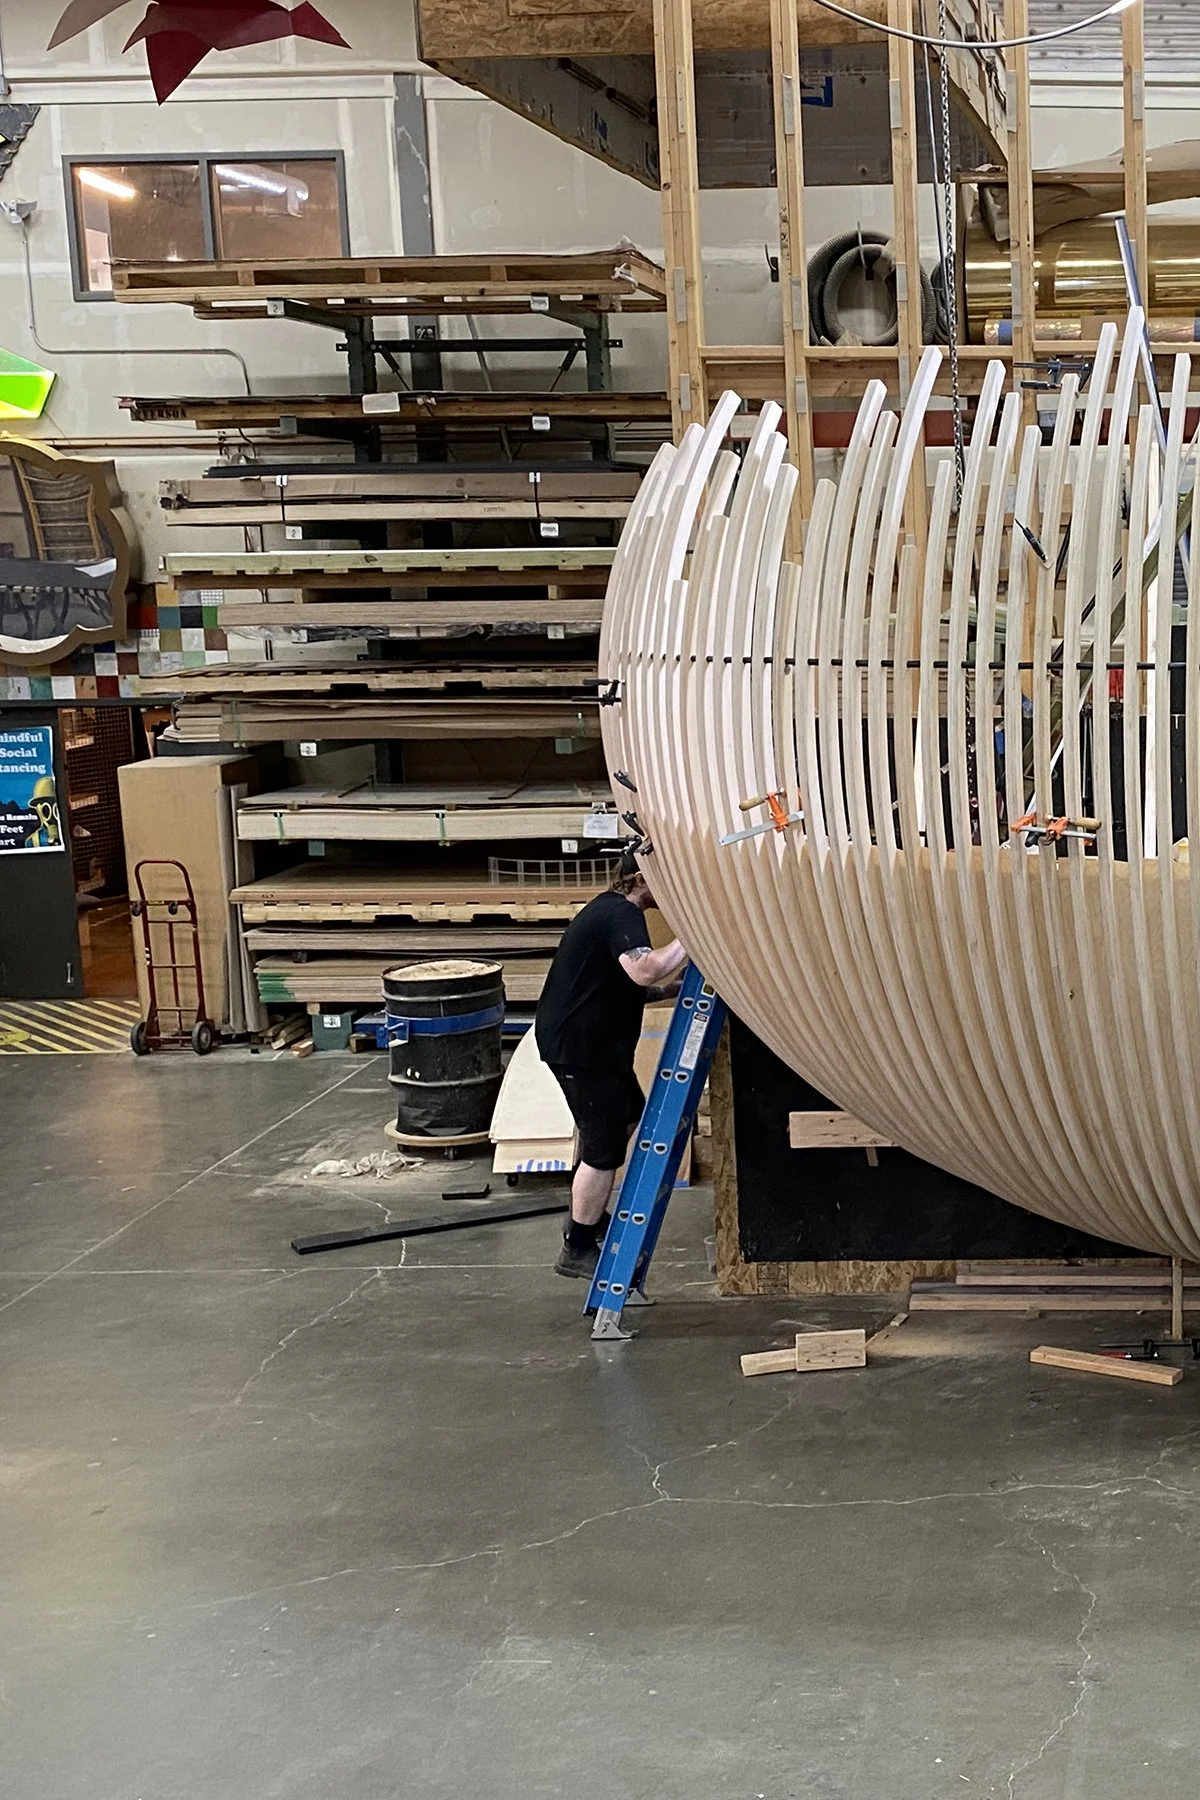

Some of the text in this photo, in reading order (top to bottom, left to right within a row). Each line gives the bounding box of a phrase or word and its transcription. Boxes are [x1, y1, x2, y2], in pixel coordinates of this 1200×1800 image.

[272, 304, 278, 313] 2
[291, 529, 296, 538] 2
[0, 747, 37, 758] Social
[0, 825, 24, 834] Feet
